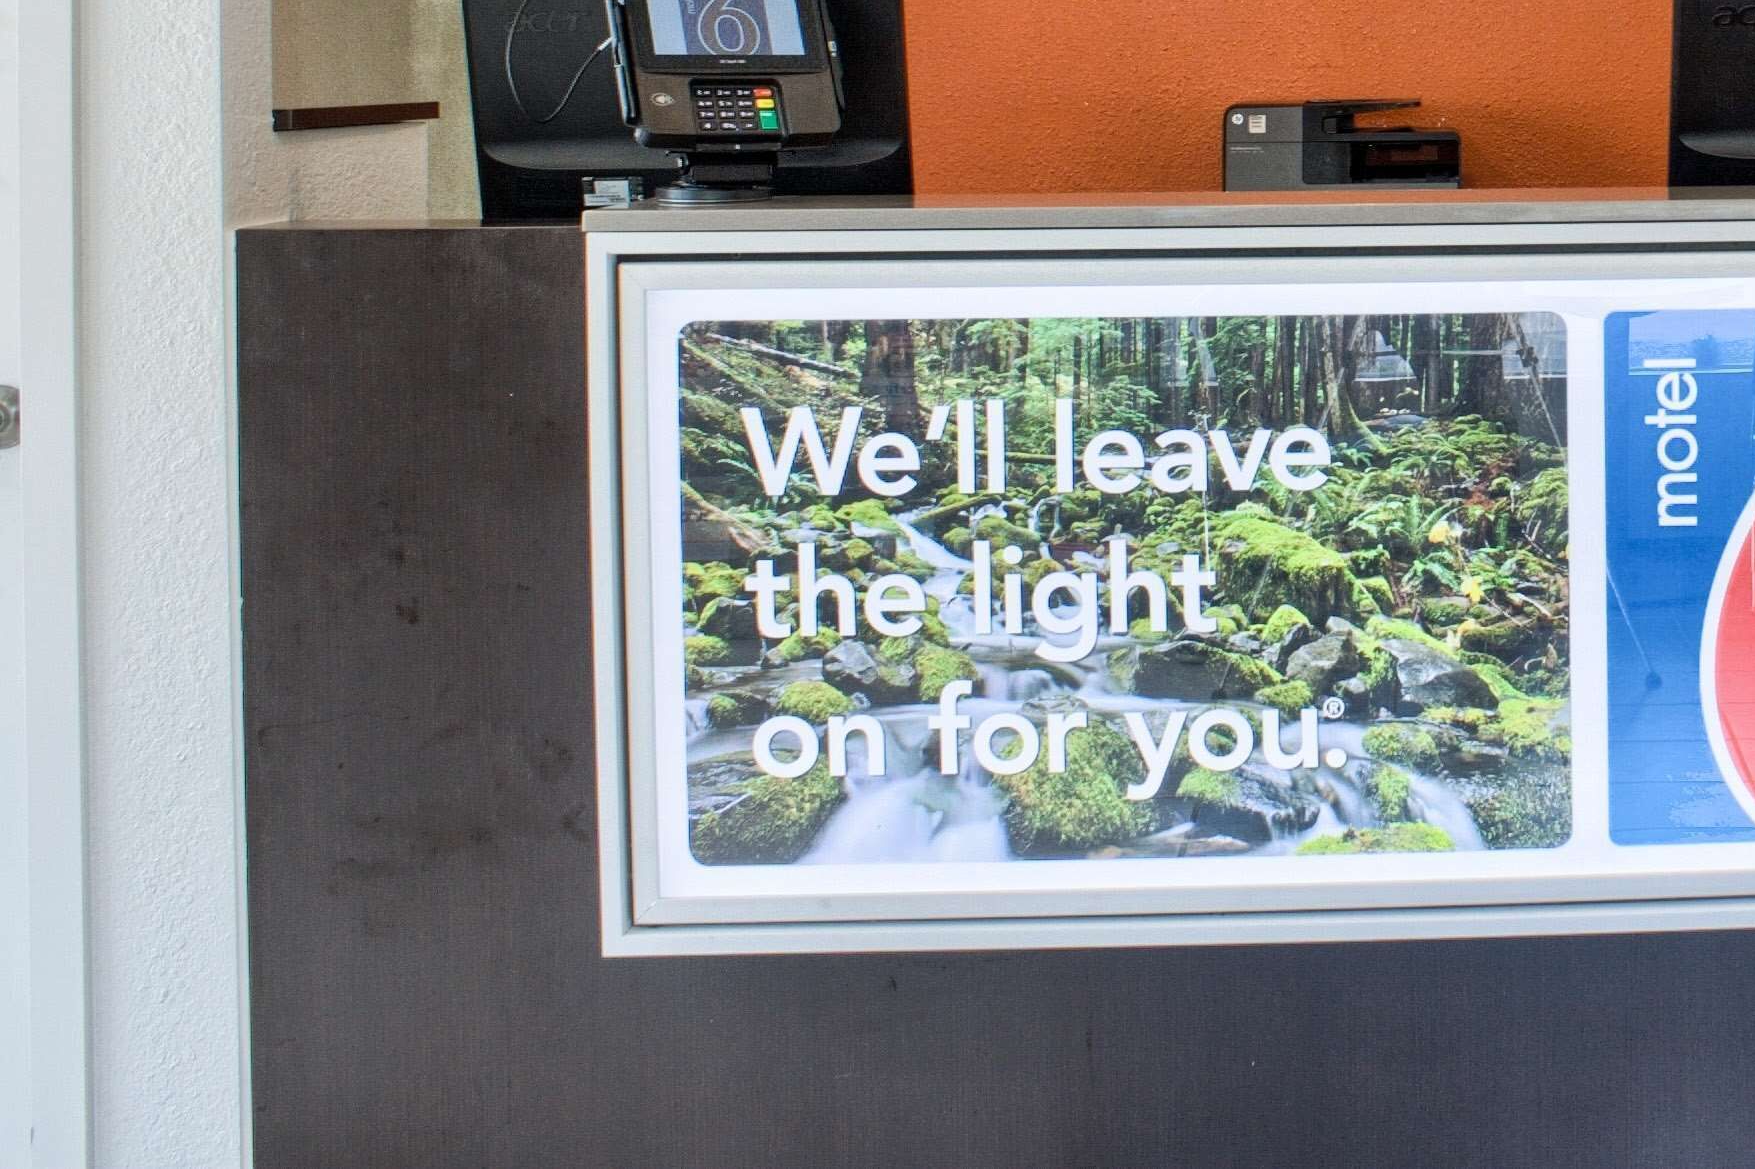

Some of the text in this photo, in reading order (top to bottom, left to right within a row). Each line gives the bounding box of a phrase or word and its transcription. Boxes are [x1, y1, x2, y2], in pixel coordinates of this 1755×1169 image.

[740, 398, 1332, 497] We'll leave
[1643, 357, 1698, 527] motel
[744, 538, 1218, 663] the light
[752, 714, 887, 779] on
[928, 679, 1088, 775] for
